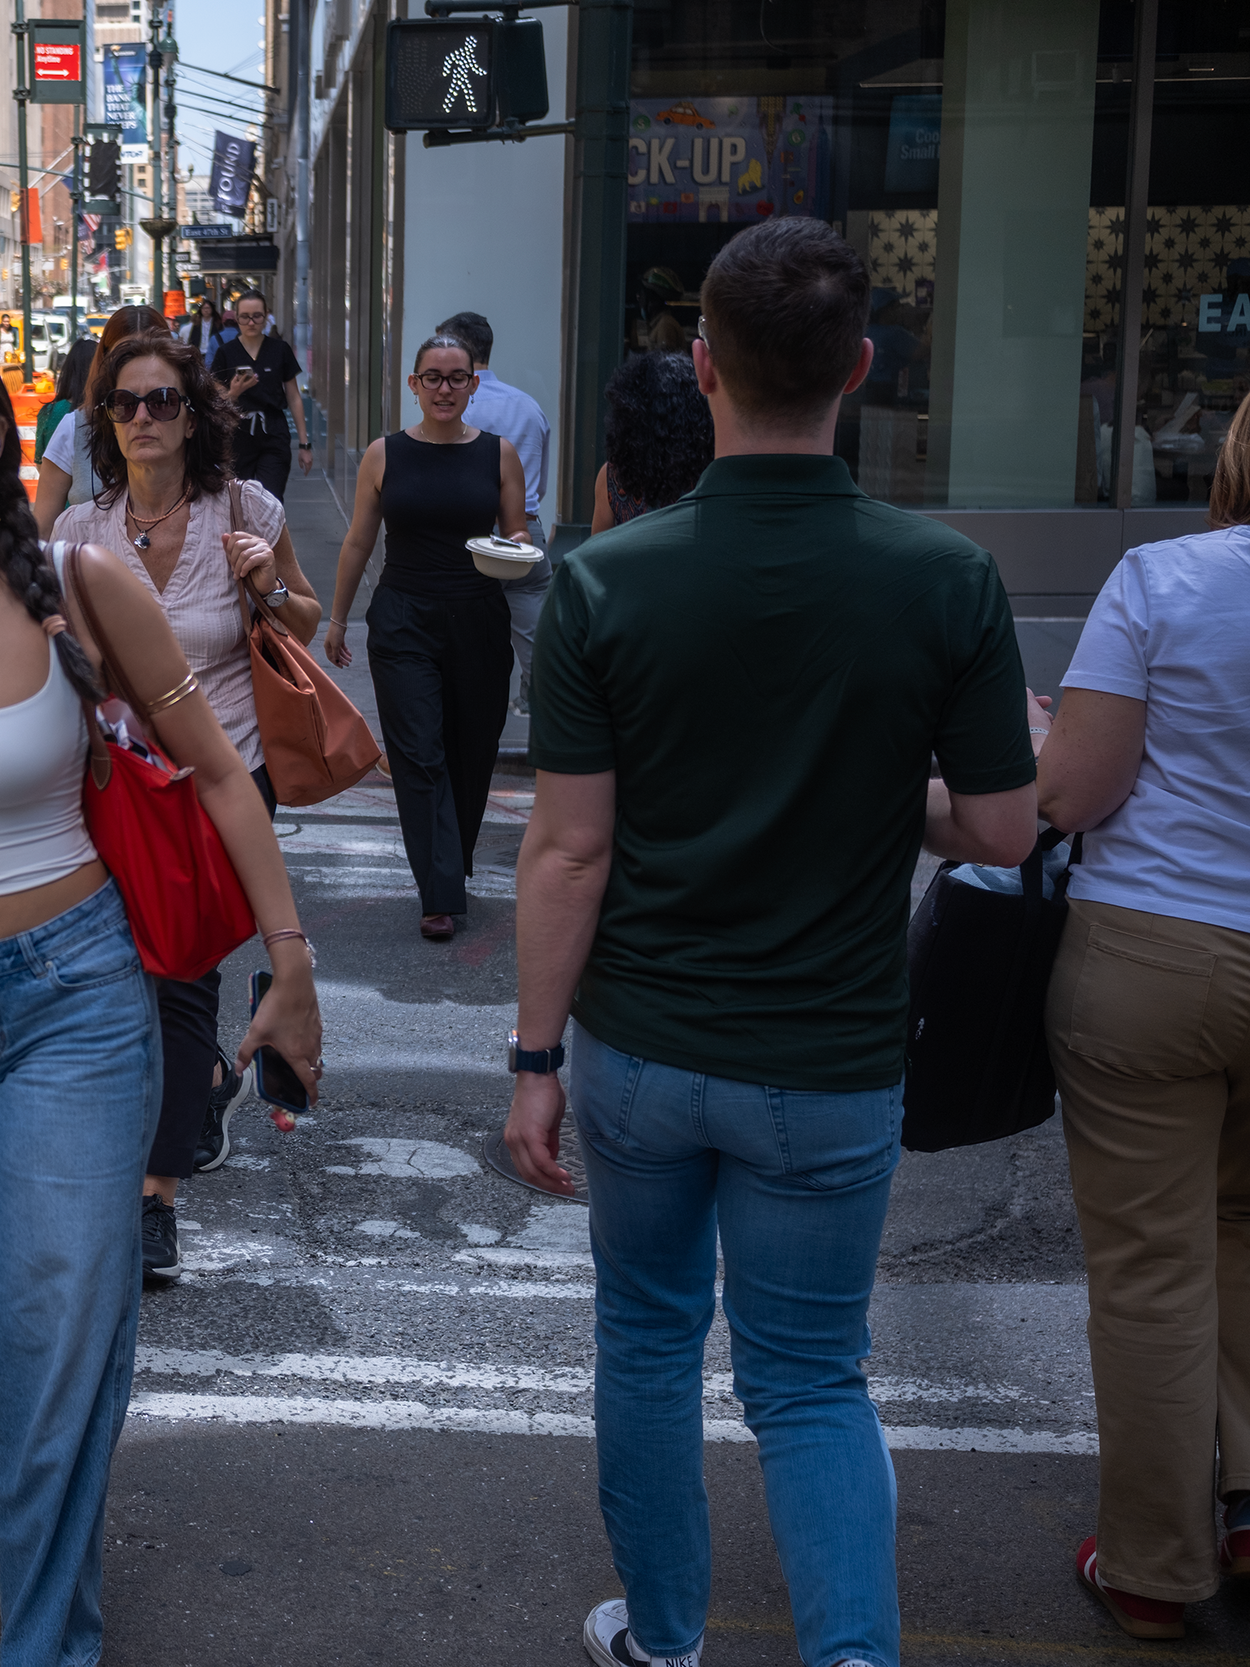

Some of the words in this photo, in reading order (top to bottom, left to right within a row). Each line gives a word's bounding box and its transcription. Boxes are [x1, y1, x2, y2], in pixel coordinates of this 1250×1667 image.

[45, 47, 74, 55] STANDING
[37, 55, 61, 64] Anytime
[106, 84, 124, 93] THE
[106, 94, 130, 102] BANK
[106, 103, 130, 111] THAT
[106, 112, 136, 121] NEVER
[185, 228, 201, 236] East
[202, 228, 219, 236] 47th
[219, 228, 229, 236] St
[665, 1656, 694, 1667] NIKE
